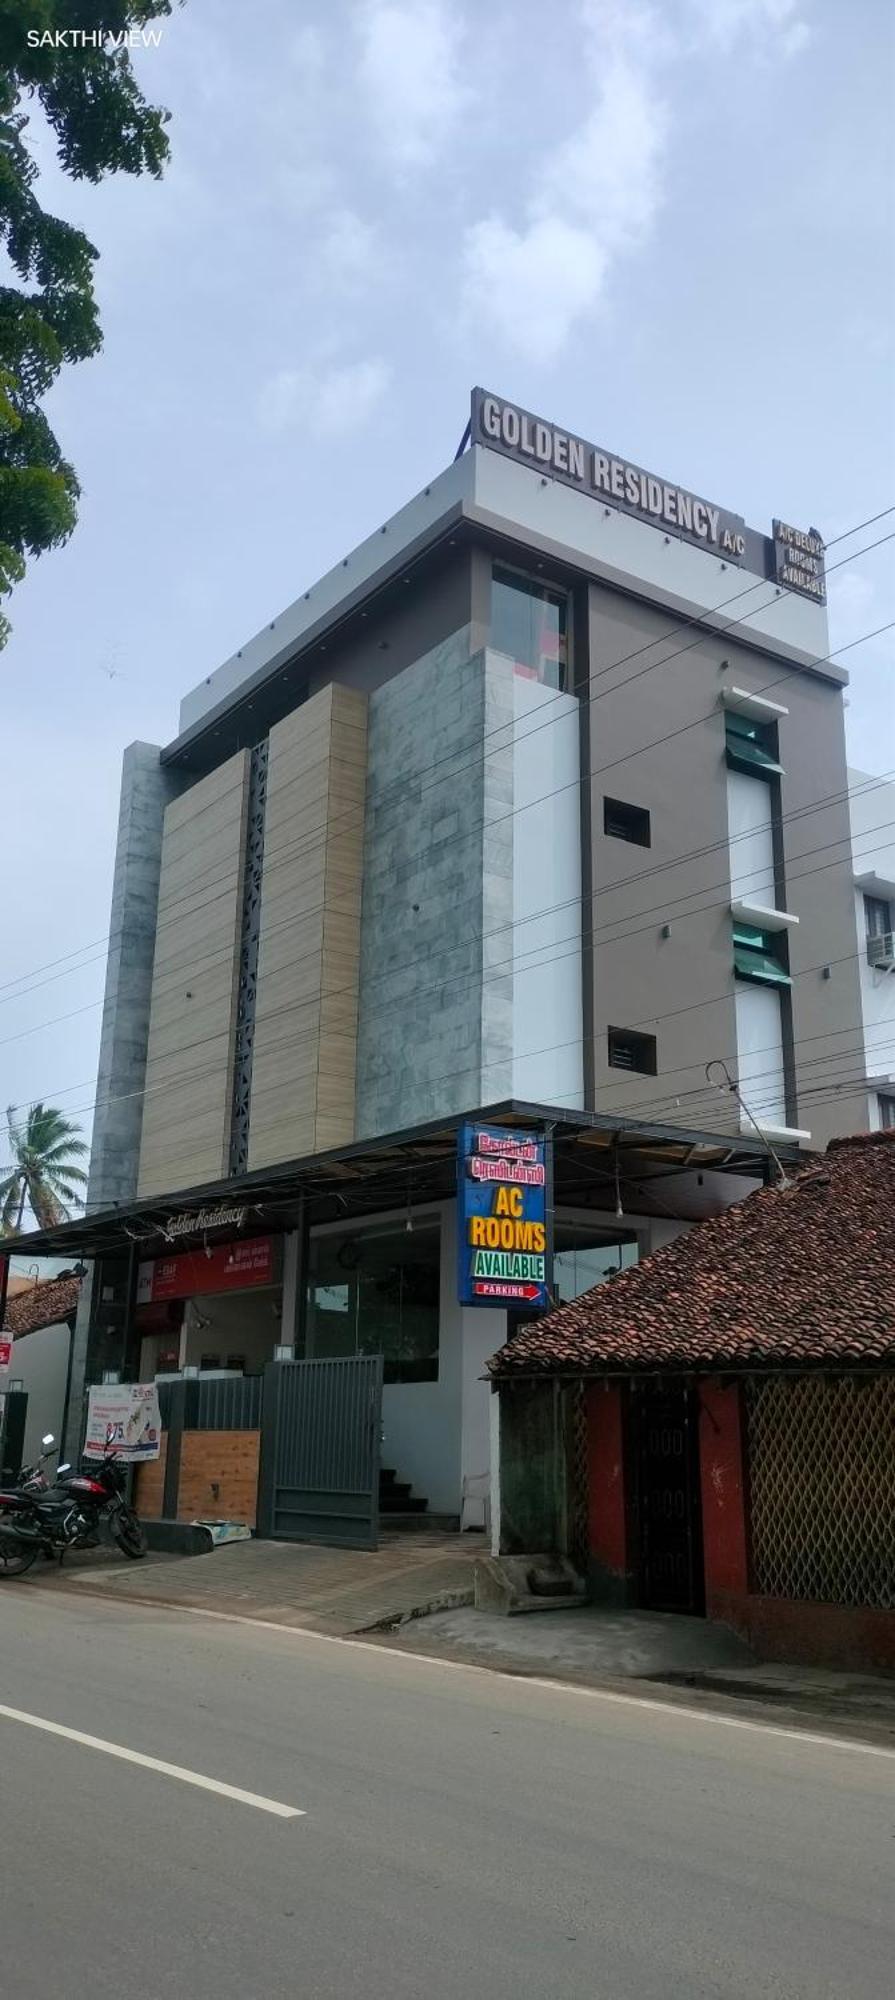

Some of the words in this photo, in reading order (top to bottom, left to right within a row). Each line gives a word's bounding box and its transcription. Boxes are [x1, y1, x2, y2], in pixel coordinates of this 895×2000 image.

[483, 399, 584, 478] GOLDEN
[594, 451, 719, 544] RESIDENCY
[721, 529, 745, 556] A/C
[496, 1187, 523, 1217] AC
[472, 1216, 545, 1252] ROOMS
[476, 1251, 544, 1280] AVAILABLE
[483, 1283, 524, 1297] PARKING
